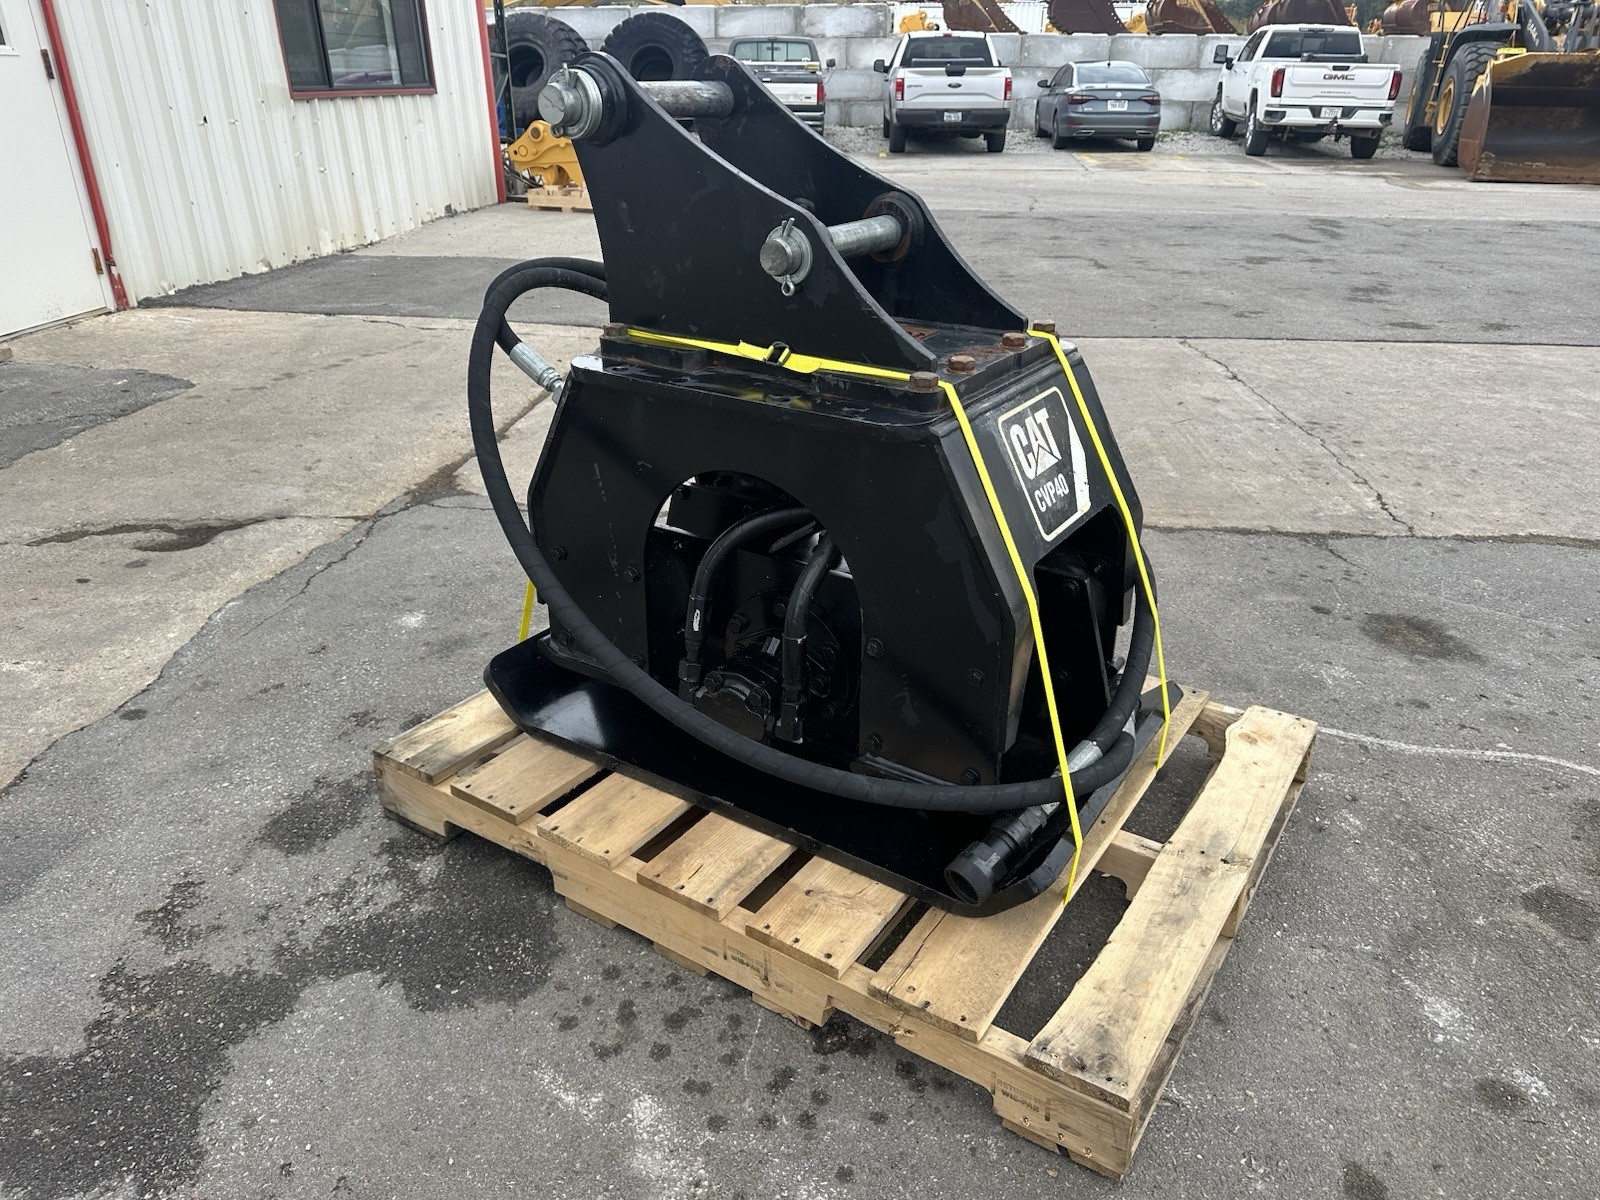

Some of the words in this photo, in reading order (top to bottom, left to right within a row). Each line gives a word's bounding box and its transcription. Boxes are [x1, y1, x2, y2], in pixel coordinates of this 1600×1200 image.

[1322, 73, 1356, 81] GMC
[1009, 407, 1062, 480] CAT
[1034, 473, 1070, 513] CVP40
